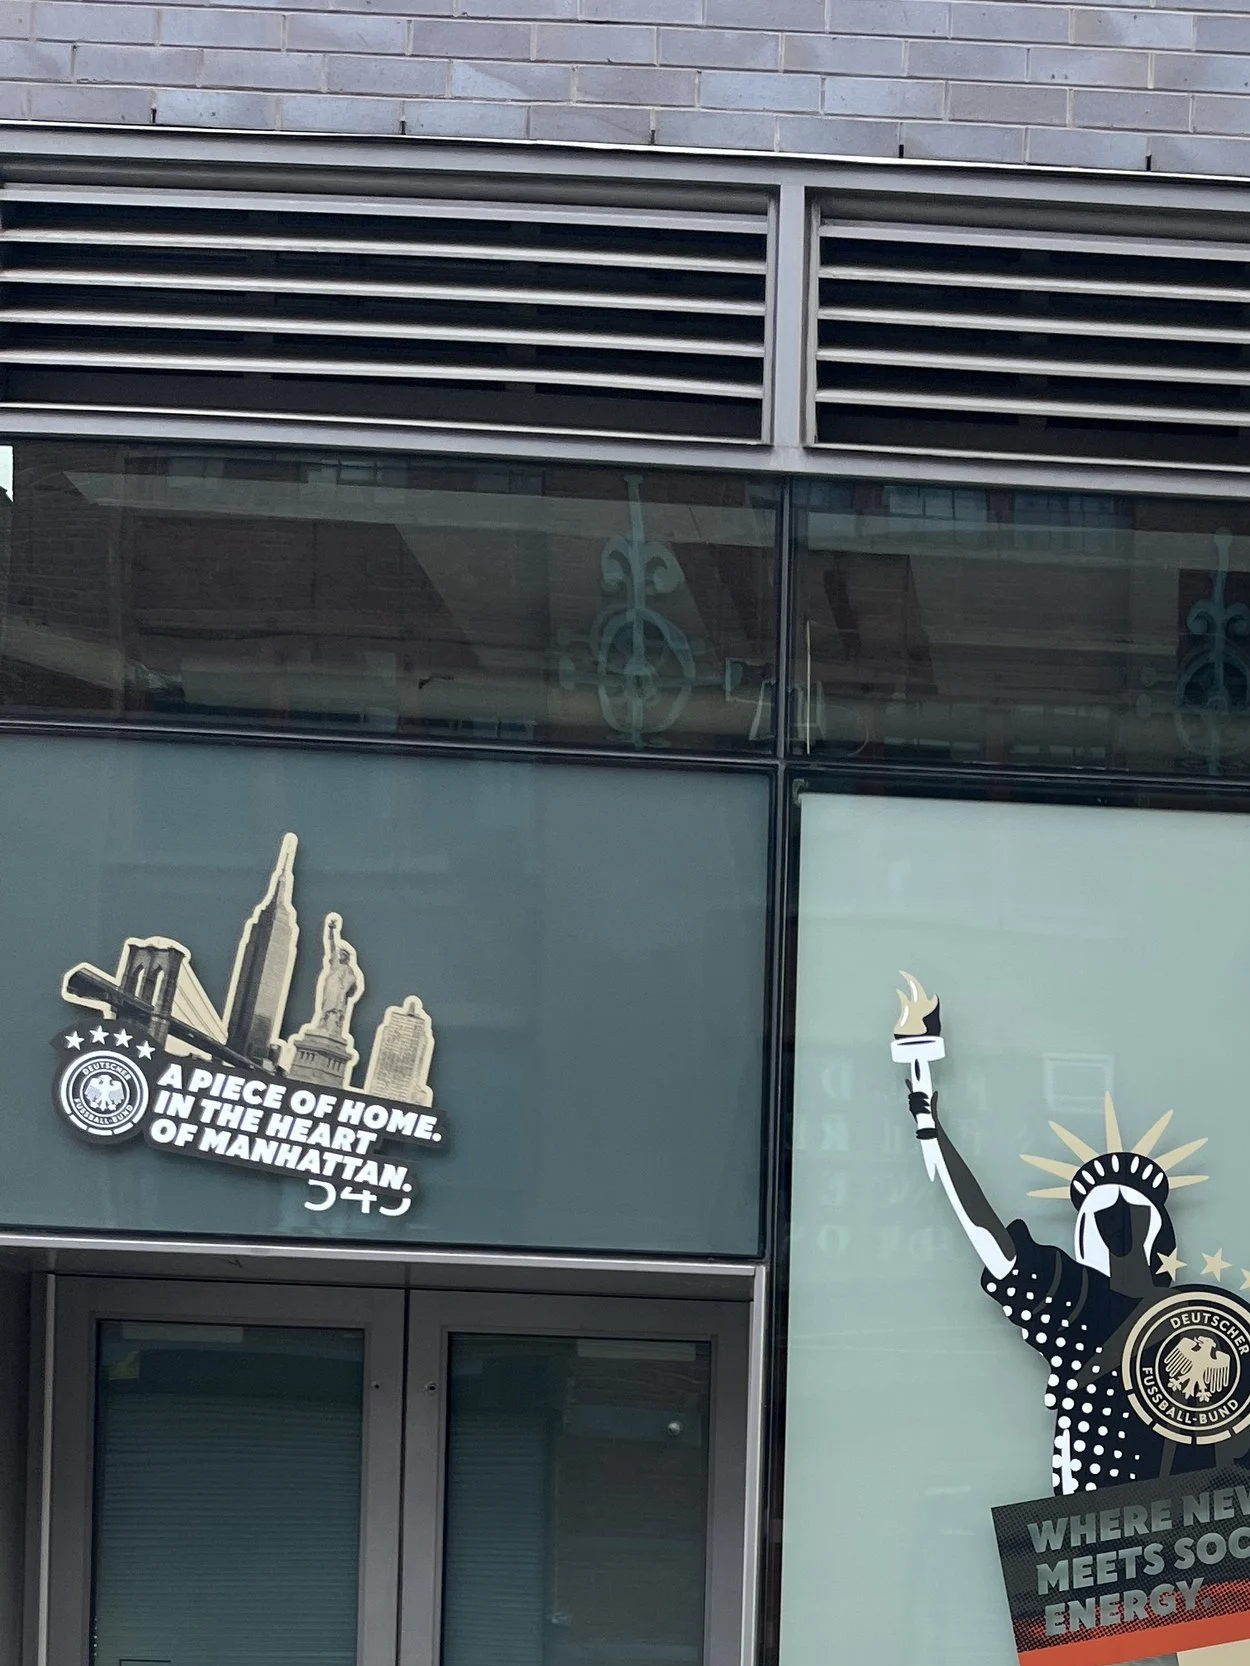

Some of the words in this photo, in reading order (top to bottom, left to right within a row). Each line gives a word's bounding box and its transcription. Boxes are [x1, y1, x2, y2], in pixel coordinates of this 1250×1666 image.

[81, 1062, 131, 1081] DEUTSCHER
[154, 1089, 196, 1119] IN
[200, 1098, 264, 1133] THE
[265, 1112, 378, 1155] HEART
[157, 1063, 183, 1090] A
[188, 1068, 287, 1109] PIECE
[290, 1090, 337, 1118] OF
[337, 1099, 442, 1142] HOME.
[150, 1118, 198, 1147] OF
[198, 1127, 413, 1192] MANHATTAN.
[1170, 1311, 1250, 1356] DEUTSCHER
[1142, 1366, 1240, 1424] FUSSBALL-BUND
[1027, 1499, 1173, 1554] WHERE
[1036, 1542, 1165, 1596] MEETS
[1045, 1577, 1212, 1637] ENERGY.
